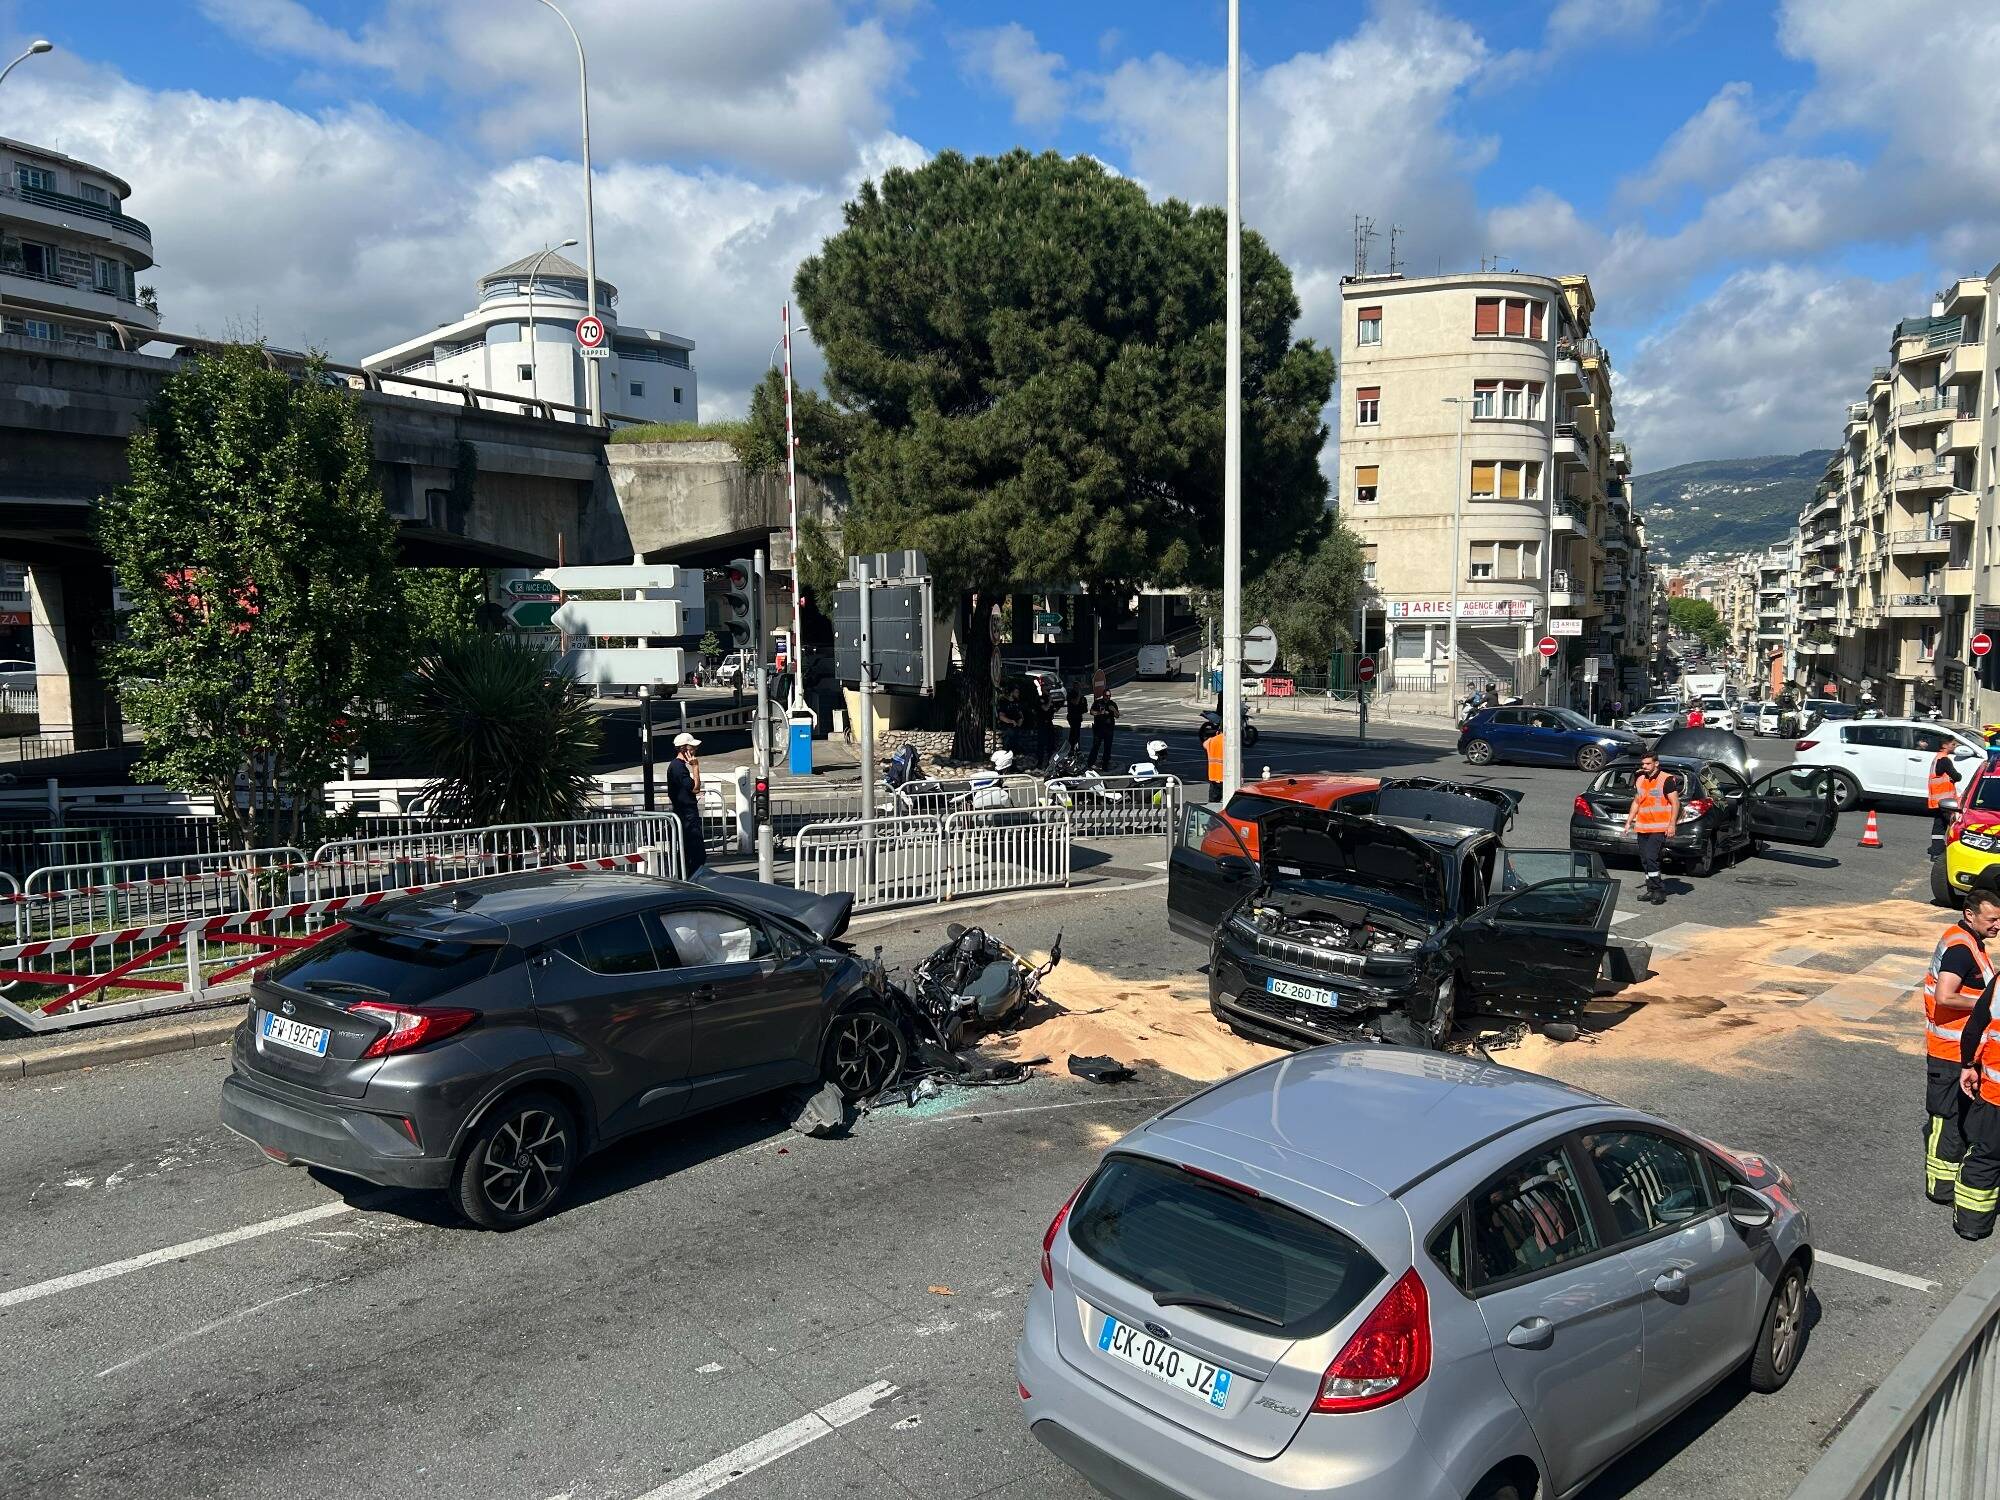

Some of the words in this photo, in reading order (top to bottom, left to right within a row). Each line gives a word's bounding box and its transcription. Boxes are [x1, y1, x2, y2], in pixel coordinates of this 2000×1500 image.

[583, 326, 598, 338] 70
[1413, 601, 1452, 613] ARIES
[1463, 601, 1494, 610] AGENCE
[1212, 1388, 1225, 1405] 38
